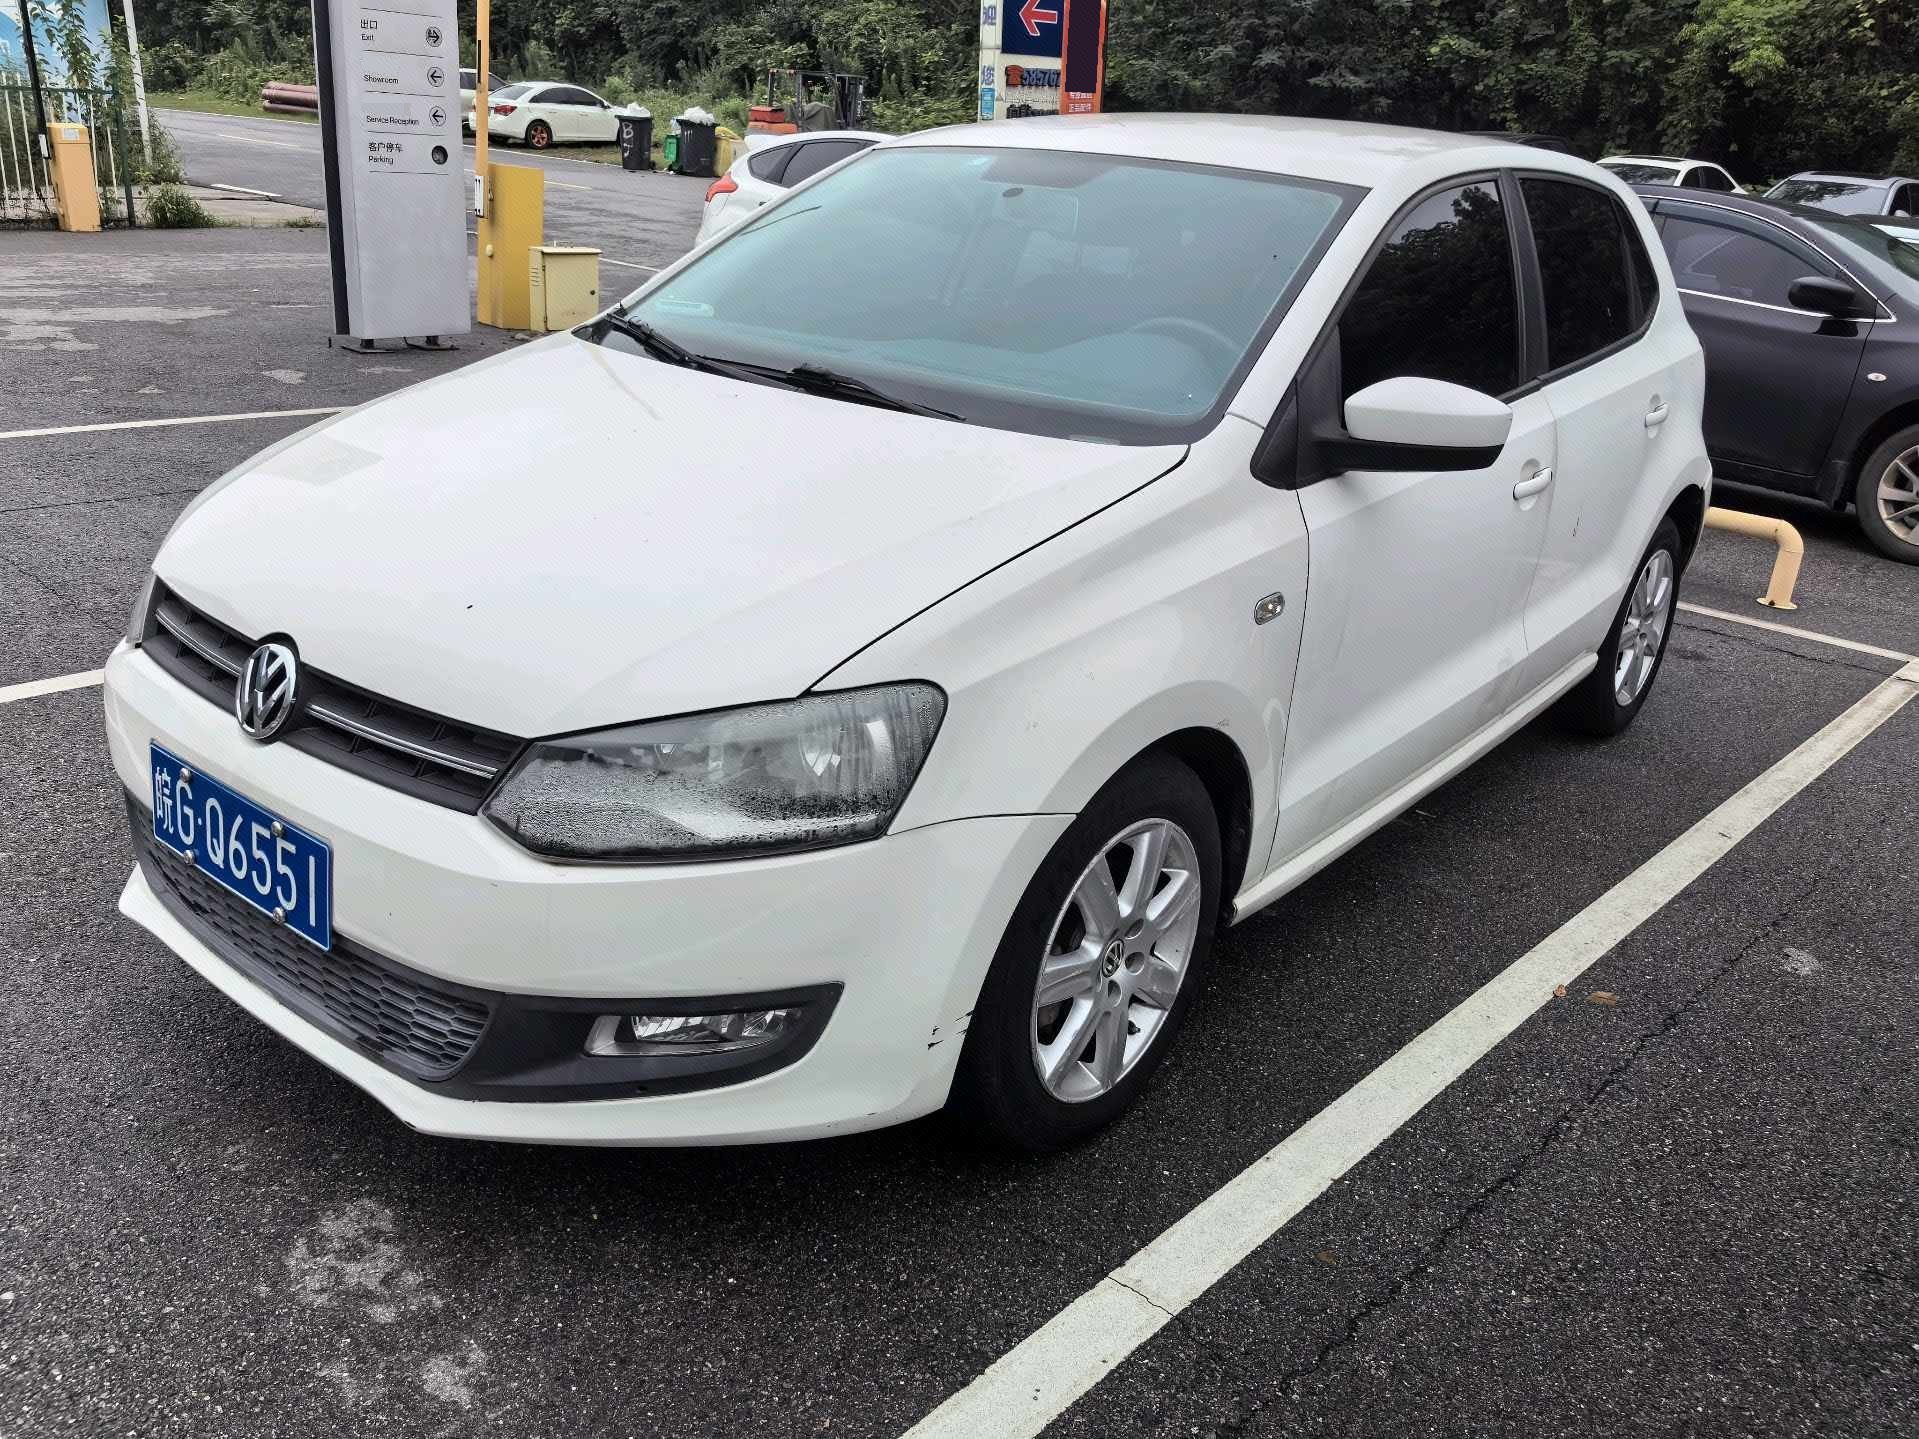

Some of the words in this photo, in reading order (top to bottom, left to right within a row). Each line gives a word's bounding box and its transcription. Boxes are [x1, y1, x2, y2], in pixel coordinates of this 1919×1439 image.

[360, 19, 378, 30] 出口
[361, 33, 374, 42] Exit
[363, 75, 398, 84] Showroom
[366, 115, 389, 124] Service
[389, 116, 420, 127] Reception
[368, 141, 403, 153] 客户停车
[368, 155, 394, 165] Parking
